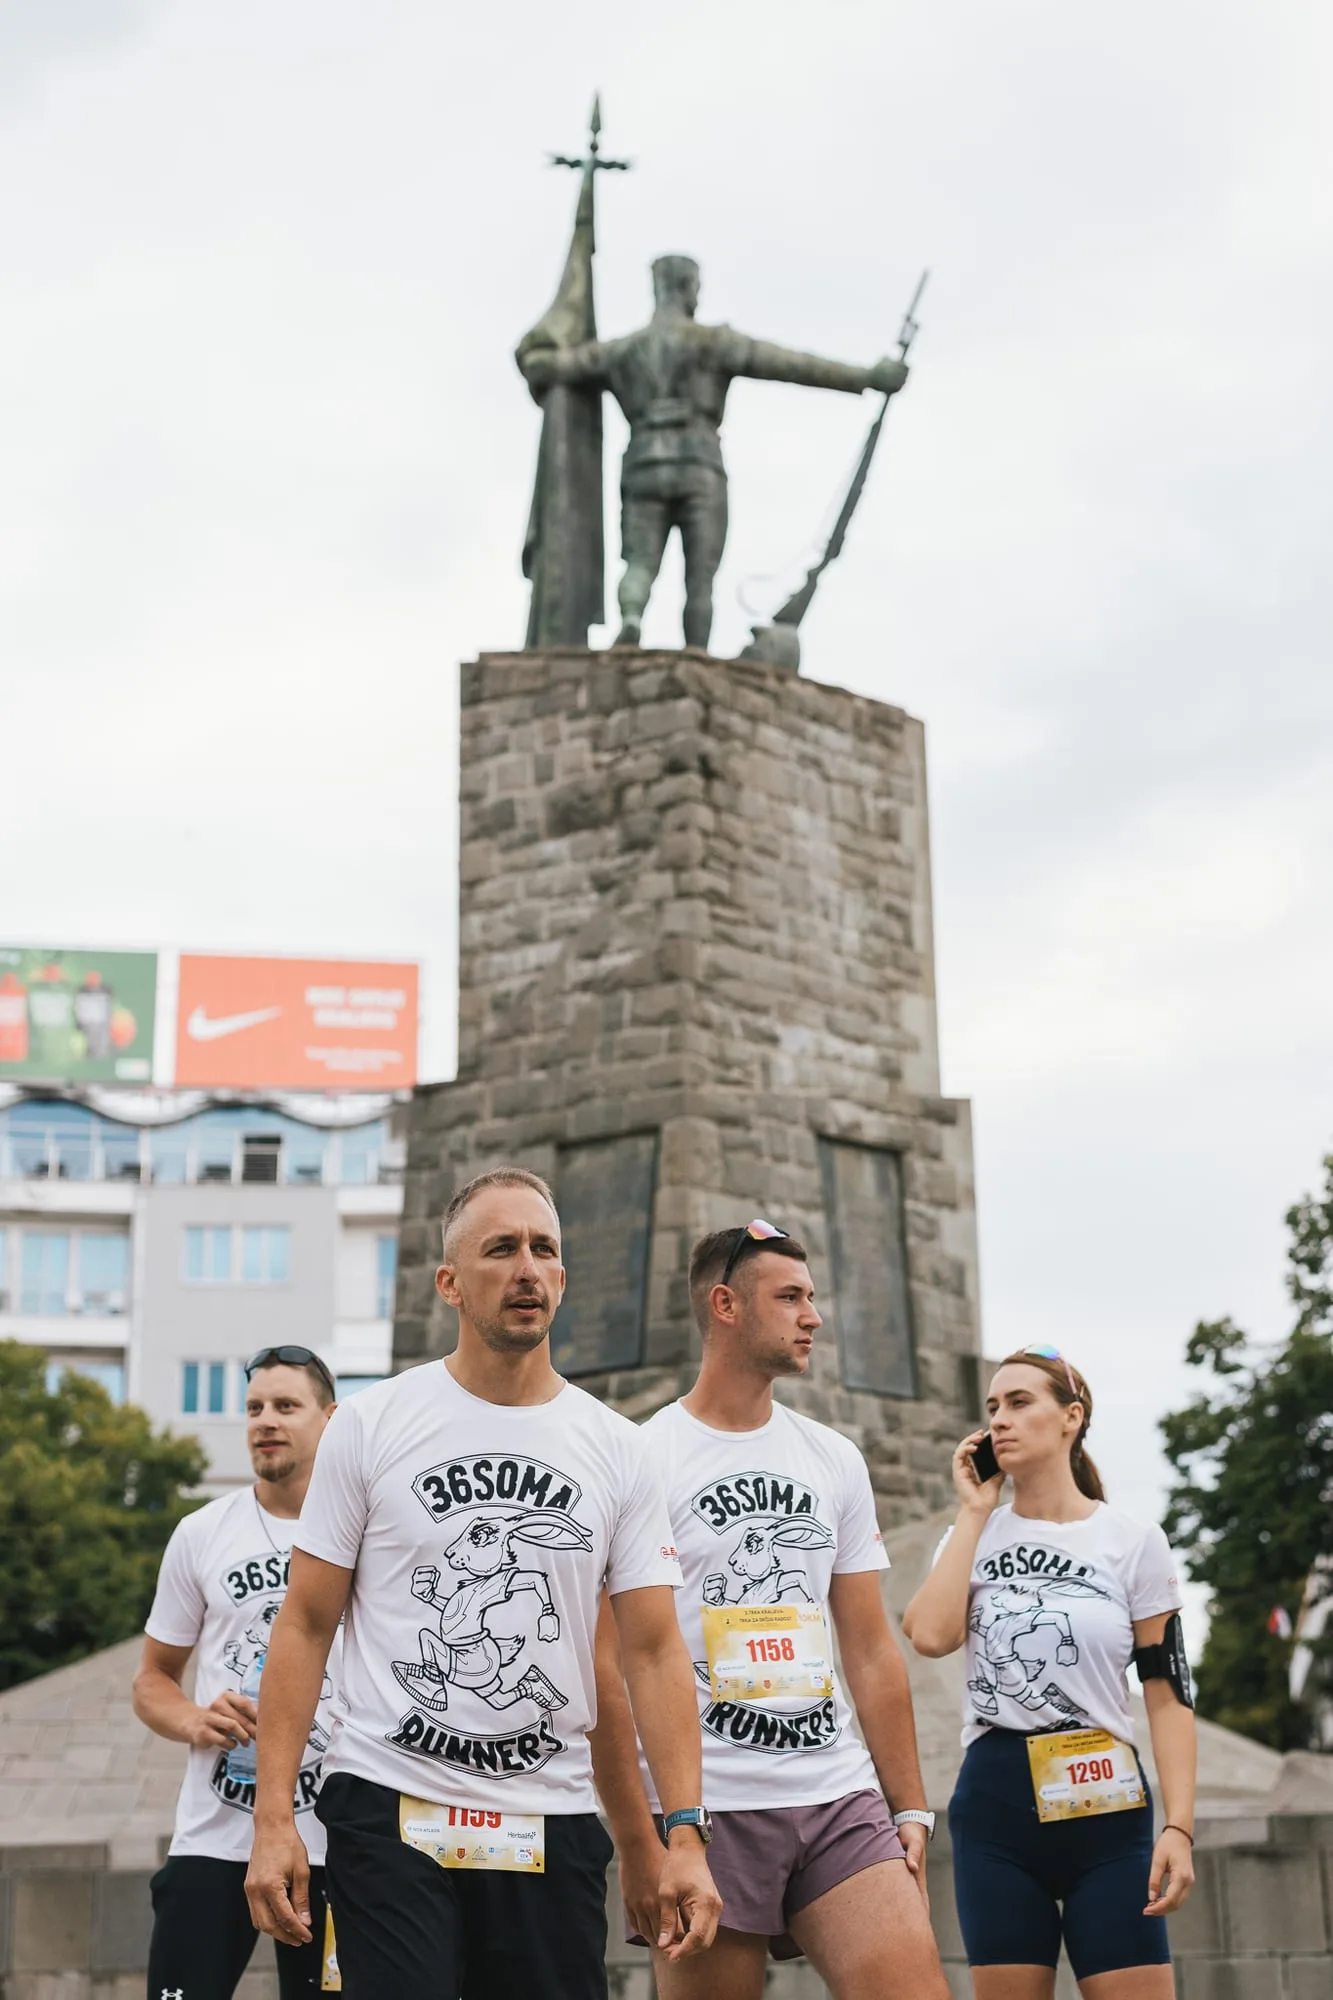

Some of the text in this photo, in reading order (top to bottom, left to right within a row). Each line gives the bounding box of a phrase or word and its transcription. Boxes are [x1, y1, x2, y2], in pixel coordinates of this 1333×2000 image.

[423, 1460, 573, 1513] 36SOMA
[700, 1477, 811, 1527] 36SOMA
[746, 1637, 796, 1662] 1158
[392, 1714, 563, 1772] RUNNERS
[705, 1700, 836, 1749] RUNNERS
[1066, 1758, 1114, 1785] 1290
[448, 1805, 502, 1829] 1159
